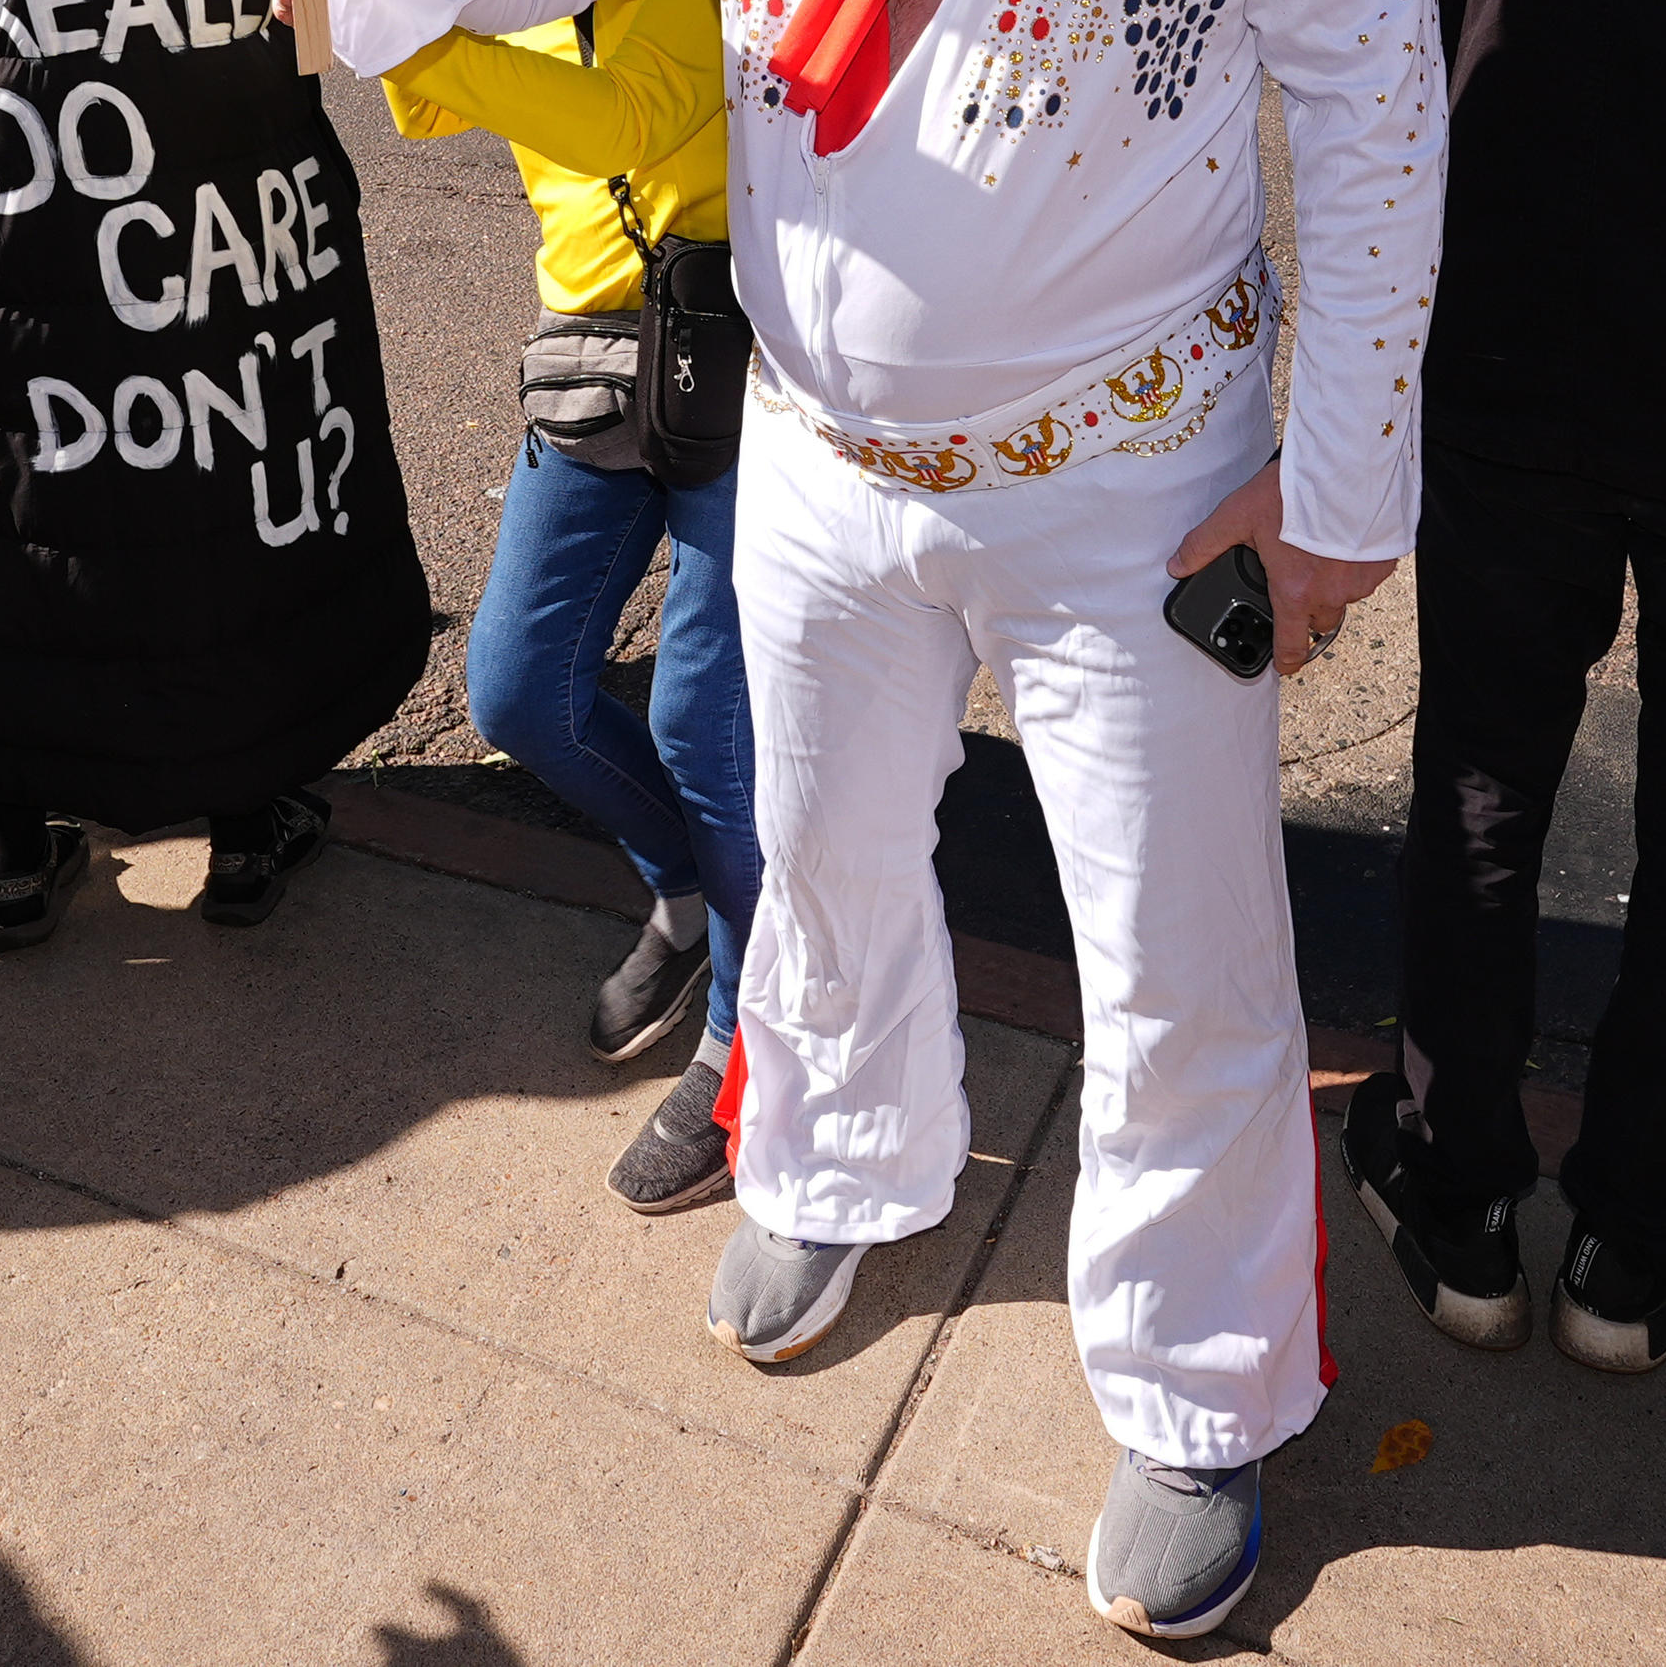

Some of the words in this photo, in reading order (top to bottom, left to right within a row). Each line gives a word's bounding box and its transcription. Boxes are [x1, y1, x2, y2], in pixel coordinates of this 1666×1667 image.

[97, 154, 340, 333] CARE
[26, 319, 339, 473] DON'T
[250, 406, 356, 547] U?
